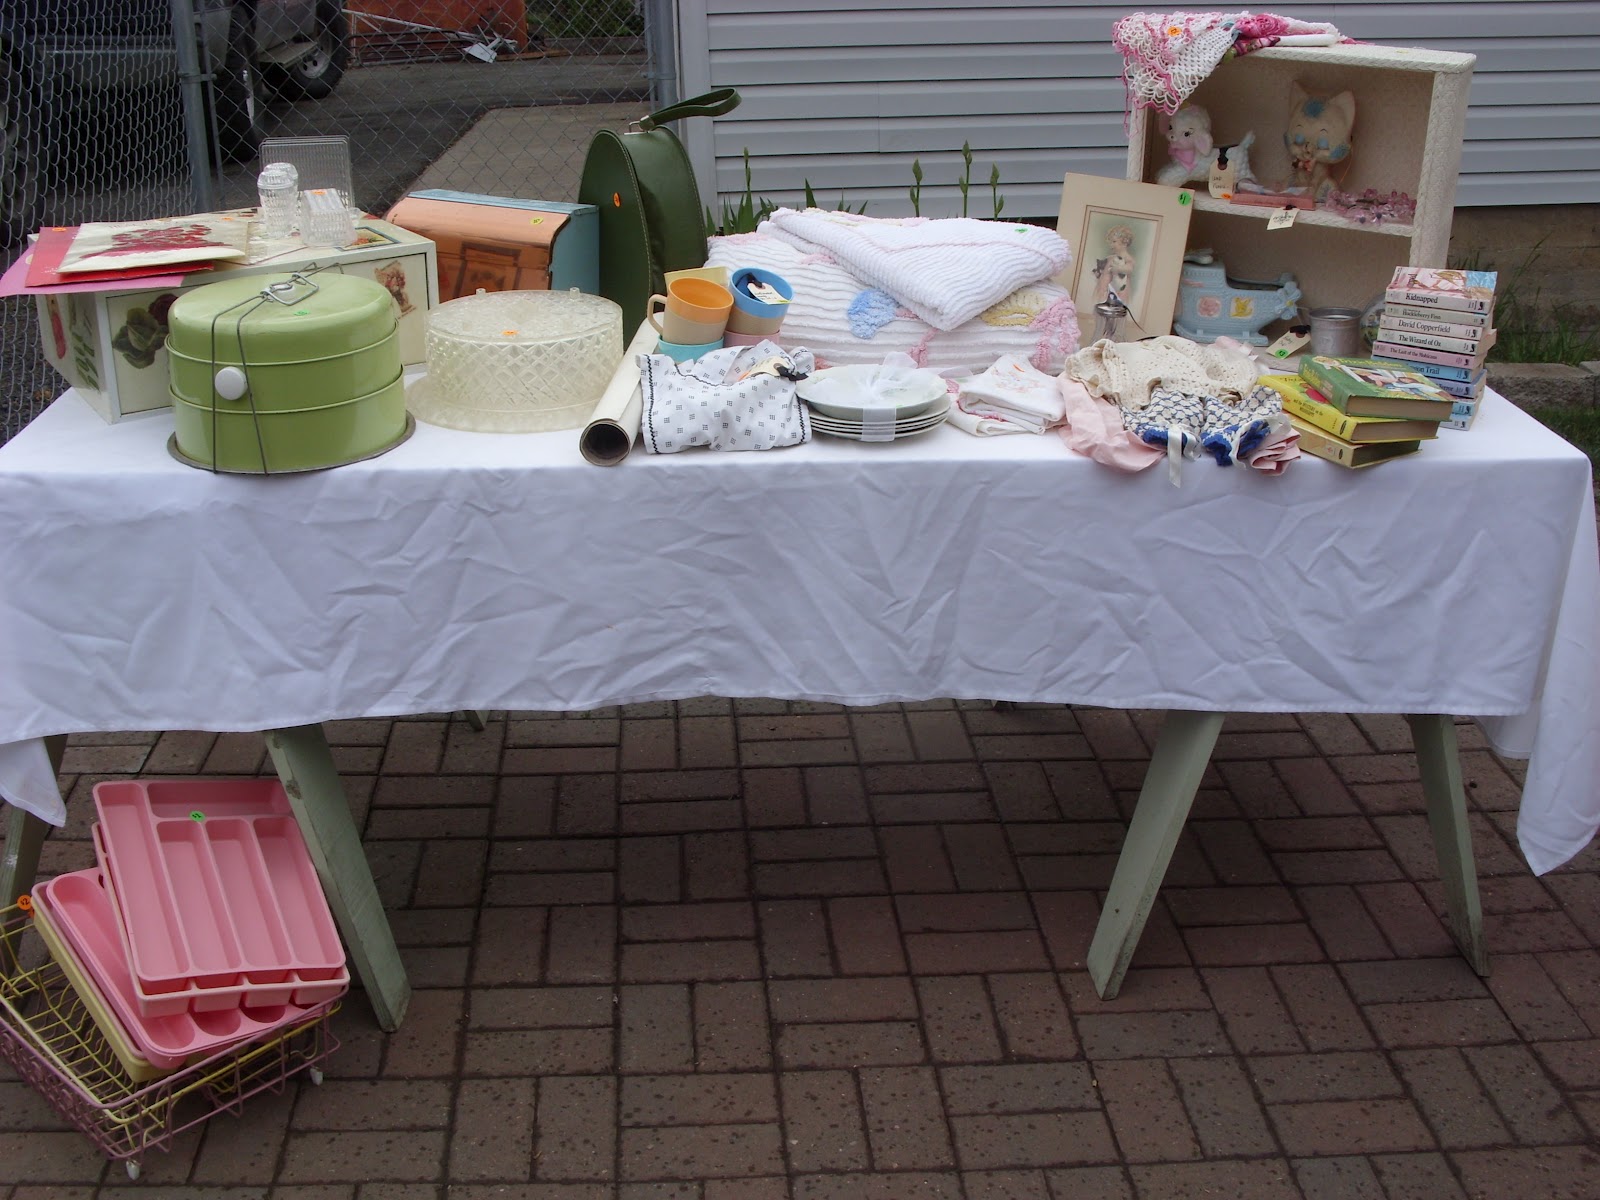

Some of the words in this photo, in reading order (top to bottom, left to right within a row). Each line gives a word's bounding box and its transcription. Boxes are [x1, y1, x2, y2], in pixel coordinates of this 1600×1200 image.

[1405, 293, 1438, 304] Kidnapped
[1402, 310, 1430, 320] Huckleberry
[1398, 319, 1415, 329] David
[1416, 323, 1451, 334] Copperfield
[1408, 336, 1427, 345] Wizard
[1428, 338, 1434, 346] of
[1434, 339, 1442, 347] Oz
[1425, 366, 1440, 375] Trail
